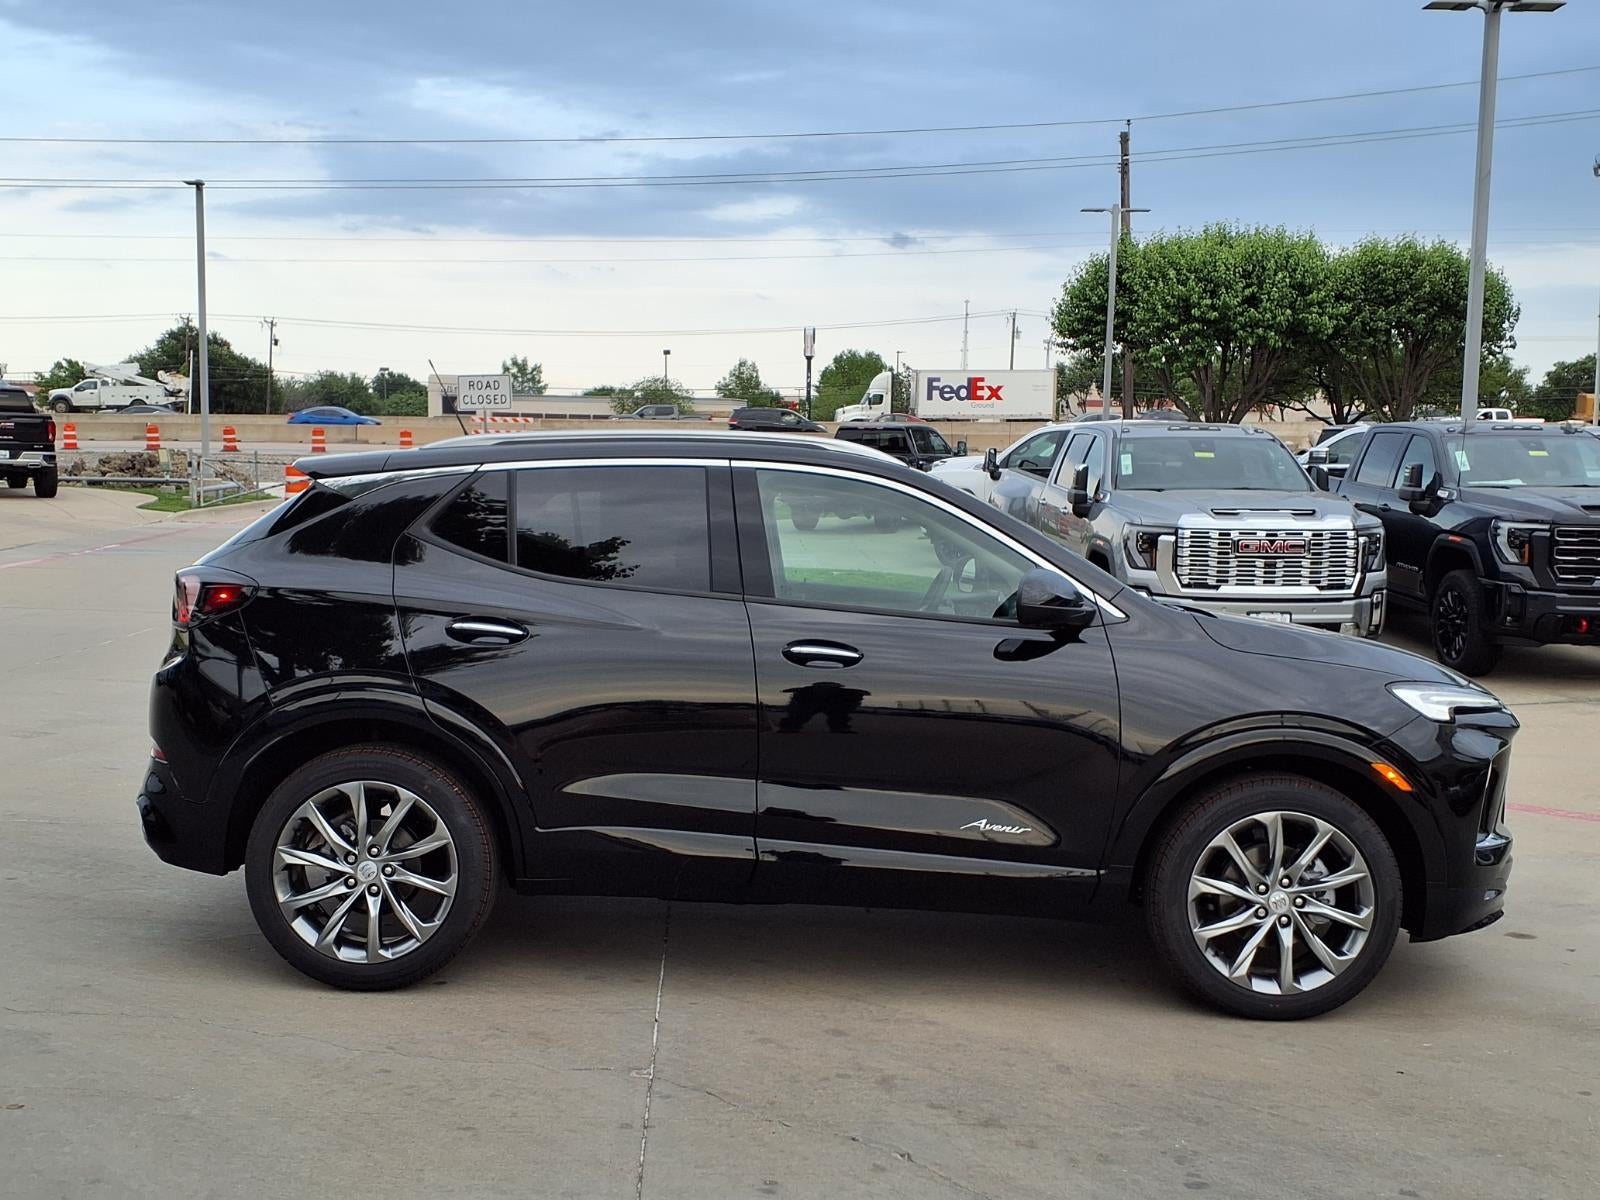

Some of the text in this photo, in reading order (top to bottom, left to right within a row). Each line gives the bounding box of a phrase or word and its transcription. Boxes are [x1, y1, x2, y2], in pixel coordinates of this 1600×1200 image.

[468, 380, 500, 391] ROAD
[926, 376, 1005, 401] FedEx
[462, 394, 507, 405] CLOSED
[970, 401, 995, 409] Ground
[1238, 540, 1305, 553] GMC
[960, 818, 1032, 834] Avenir
